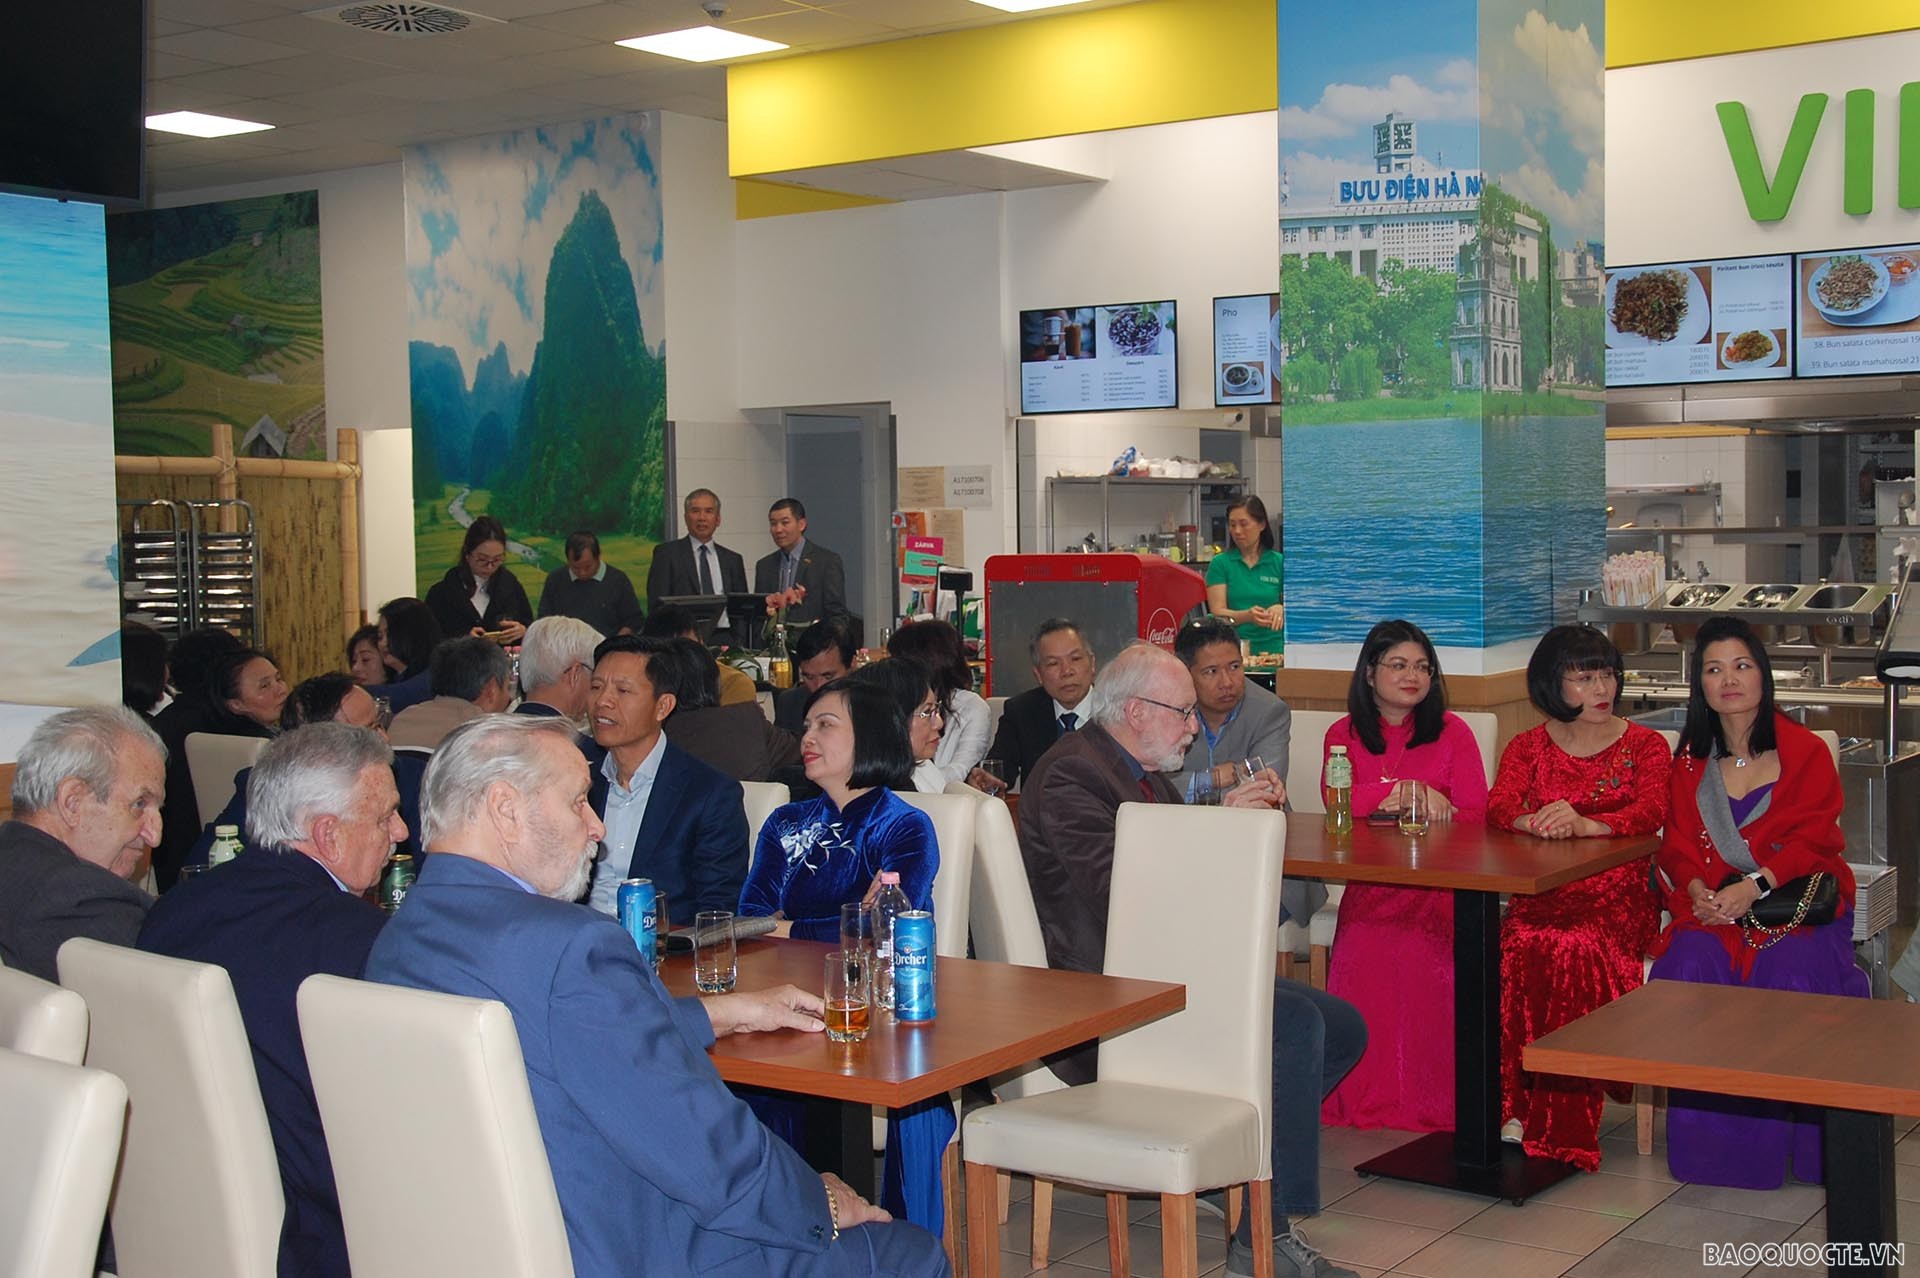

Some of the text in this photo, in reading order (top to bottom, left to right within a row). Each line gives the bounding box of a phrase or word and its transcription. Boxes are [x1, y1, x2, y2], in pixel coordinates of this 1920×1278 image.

[1715, 81, 1920, 222] VI
[1340, 179, 1380, 202] BƯU
[1385, 173, 1430, 203] ĐIỆN
[1435, 171, 1461, 198] HÀ
[895, 951, 927, 966] Dreher
